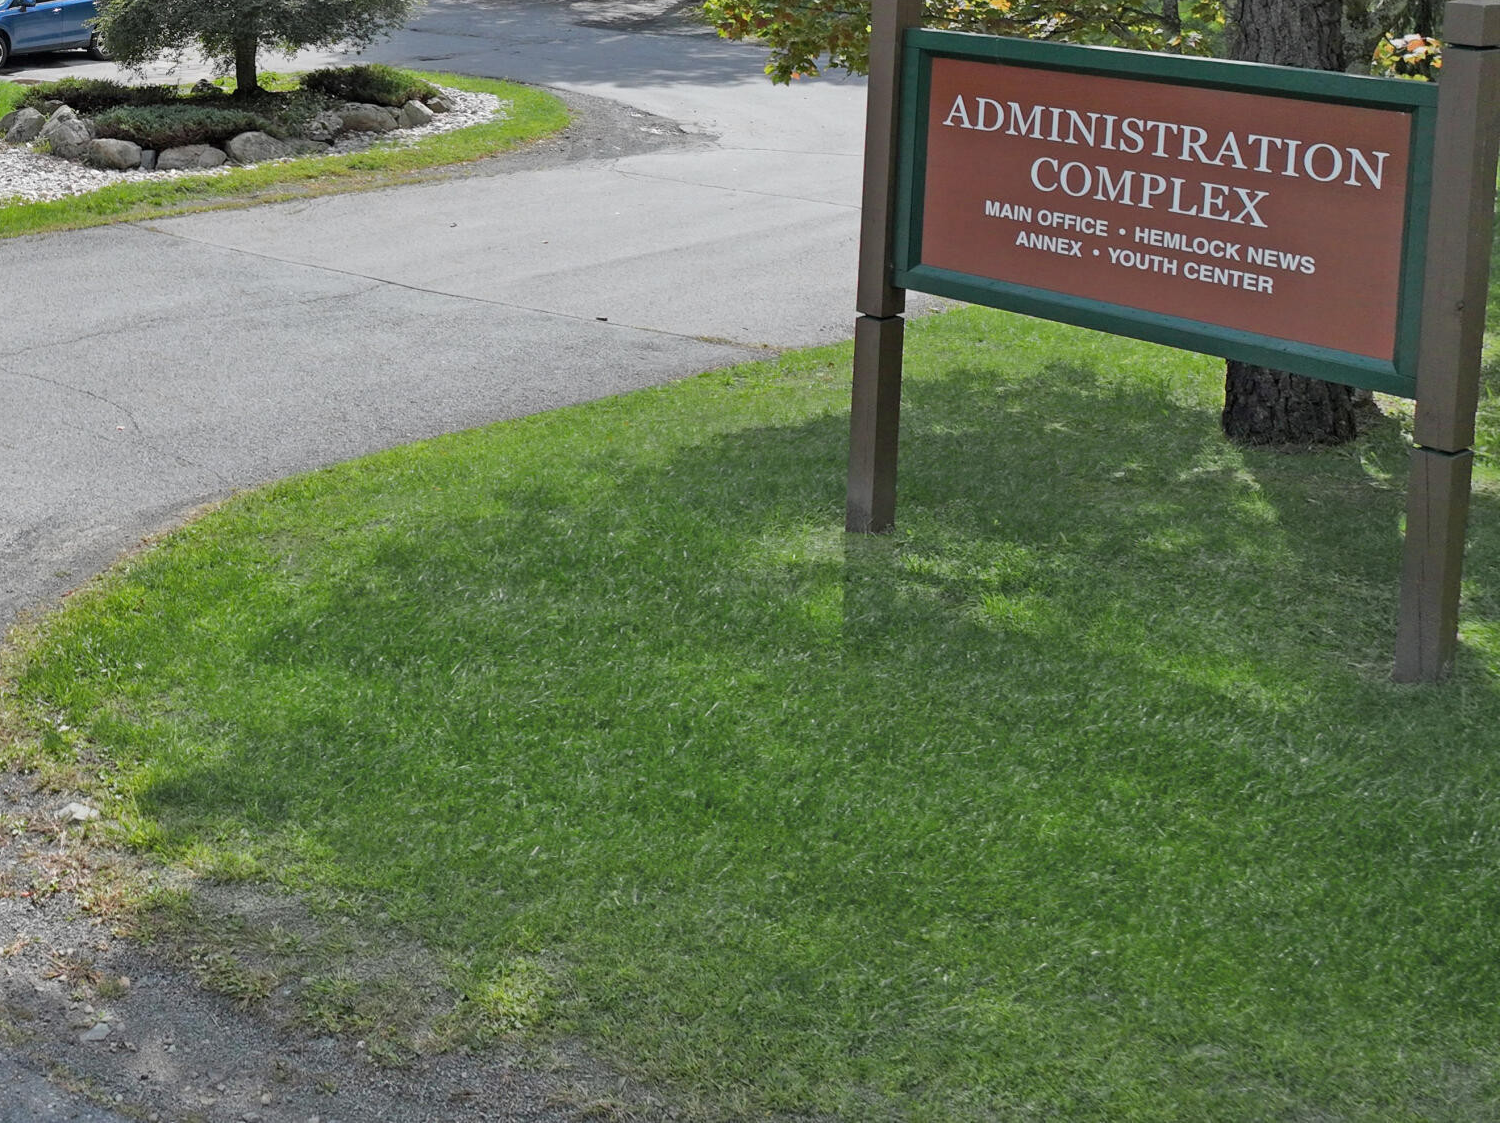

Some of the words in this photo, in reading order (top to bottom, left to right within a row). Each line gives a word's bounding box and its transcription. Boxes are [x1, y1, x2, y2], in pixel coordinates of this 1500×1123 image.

[942, 94, 1390, 189] ADMINISTRATION
[1030, 156, 1270, 229] COMPLEX
[984, 200, 1032, 224] MAIN
[1037, 211, 1109, 237] OFFICE
[1134, 226, 1242, 261] HEMLOCK
[1246, 245, 1316, 275] NEWS
[1015, 231, 1083, 258] ANNEX
[1107, 247, 1178, 277] YOUTH
[1183, 261, 1274, 294] CENTER
